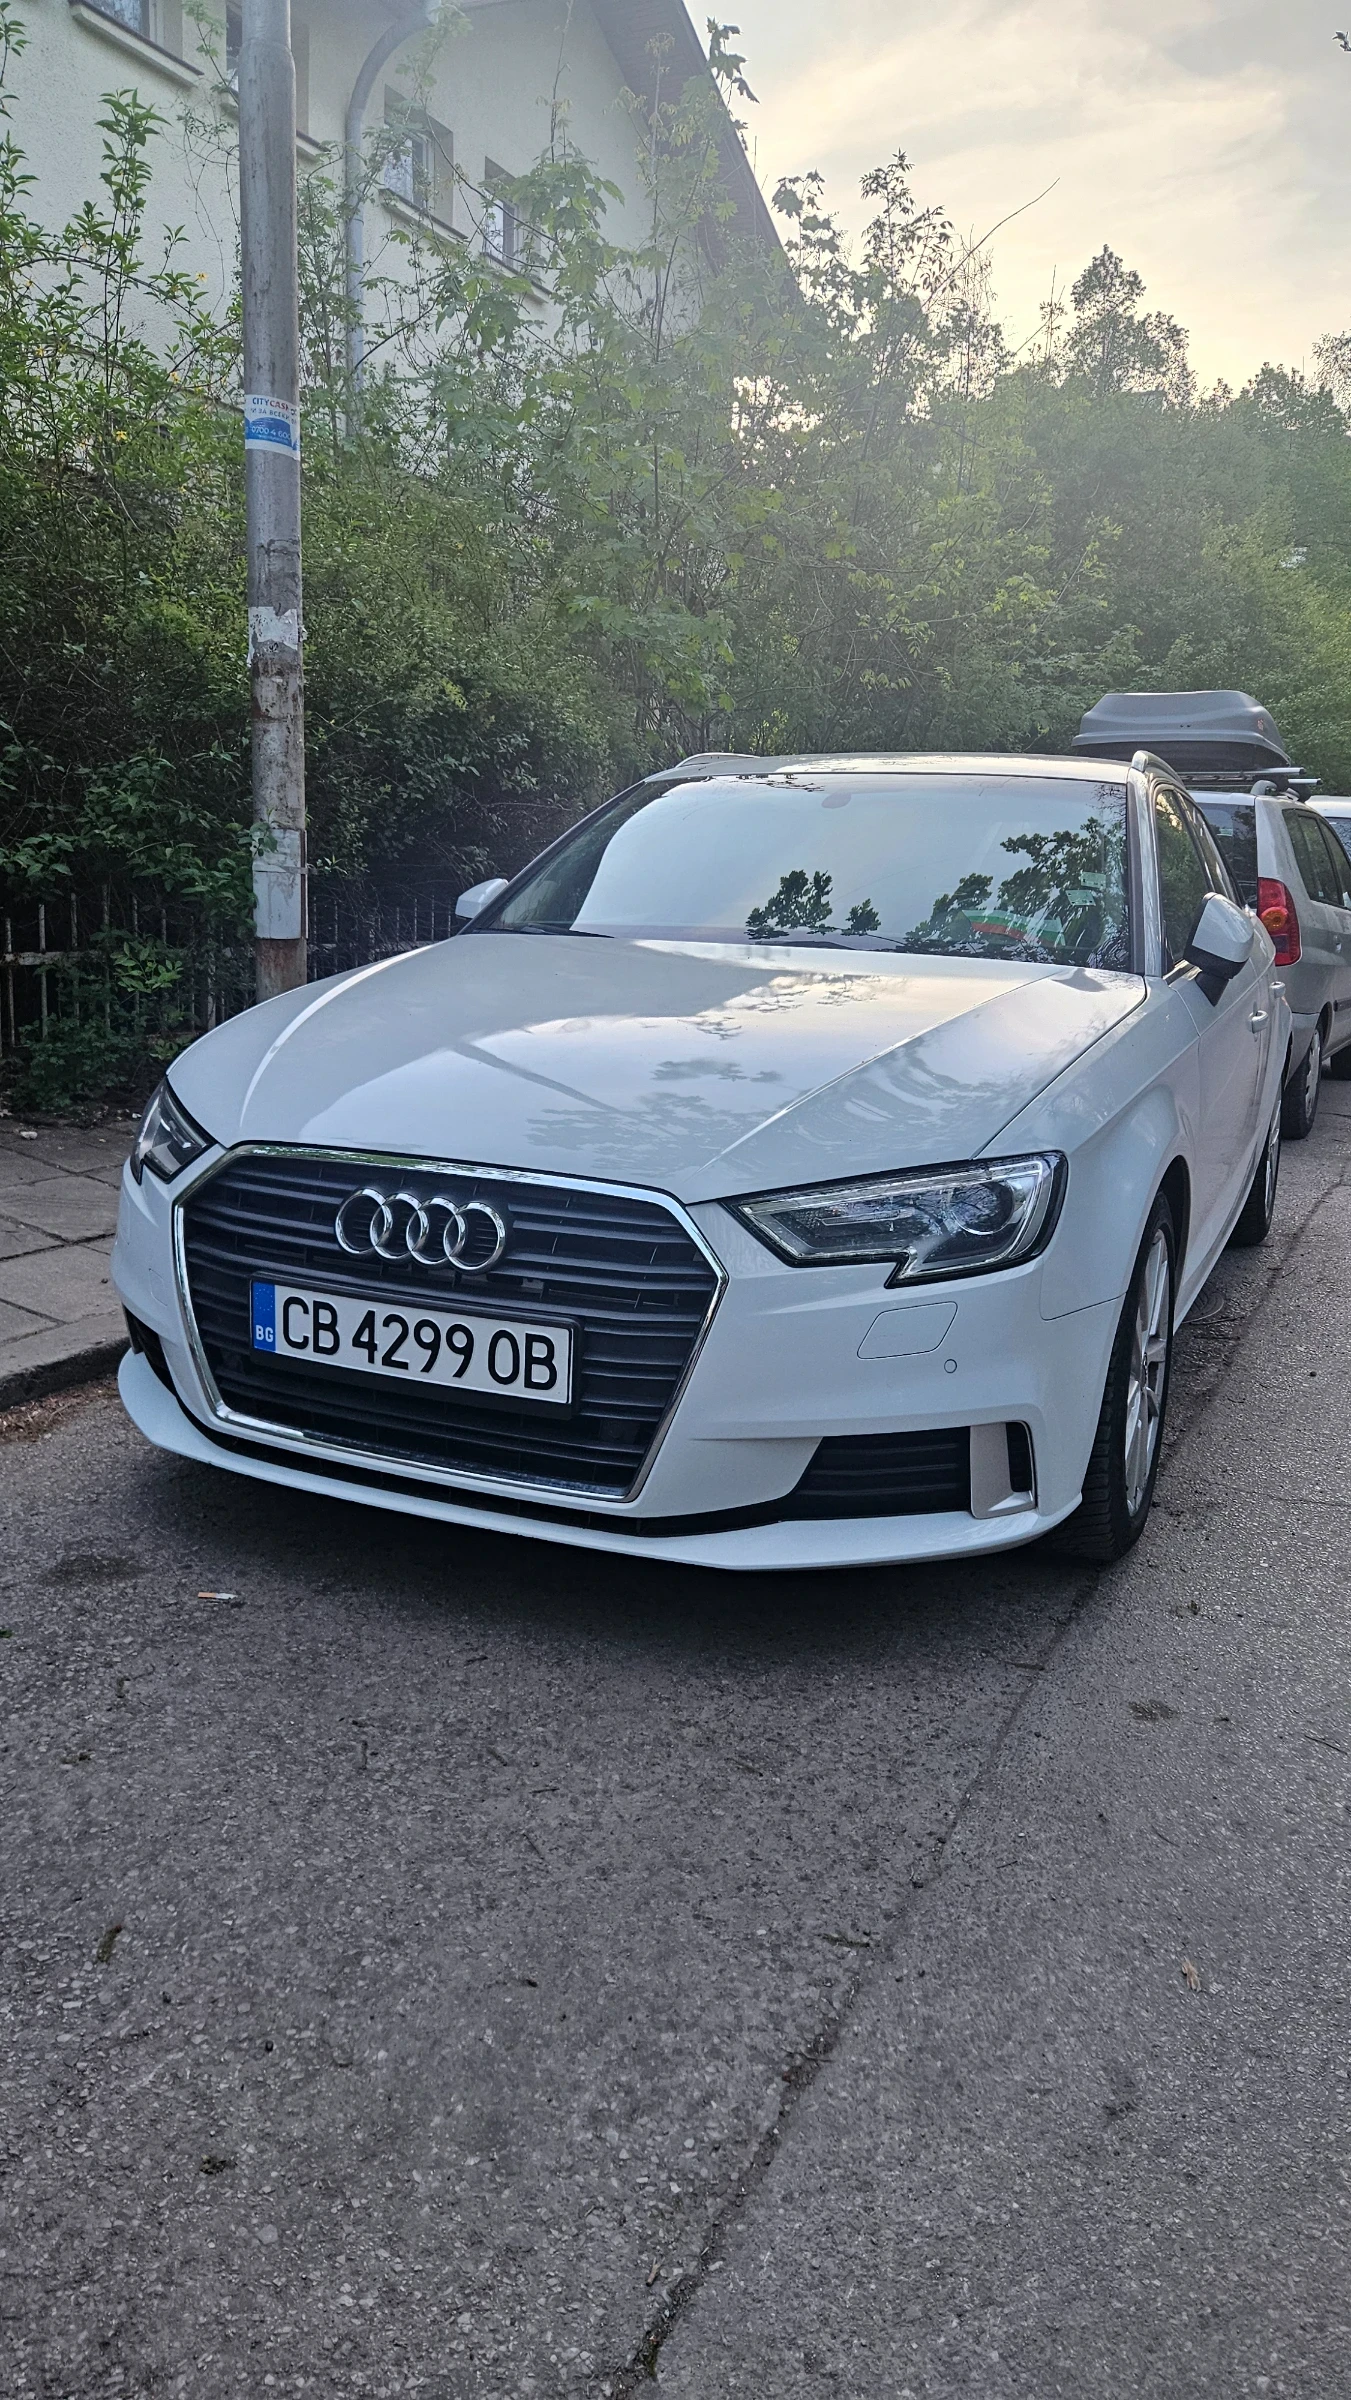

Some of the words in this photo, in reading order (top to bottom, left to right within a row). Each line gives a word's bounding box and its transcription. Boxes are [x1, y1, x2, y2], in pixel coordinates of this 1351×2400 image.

[251, 426, 269, 434] 0700
[255, 1324, 274, 1343] BG
[282, 1296, 341, 1356] CB
[351, 1309, 475, 1379] 4299
